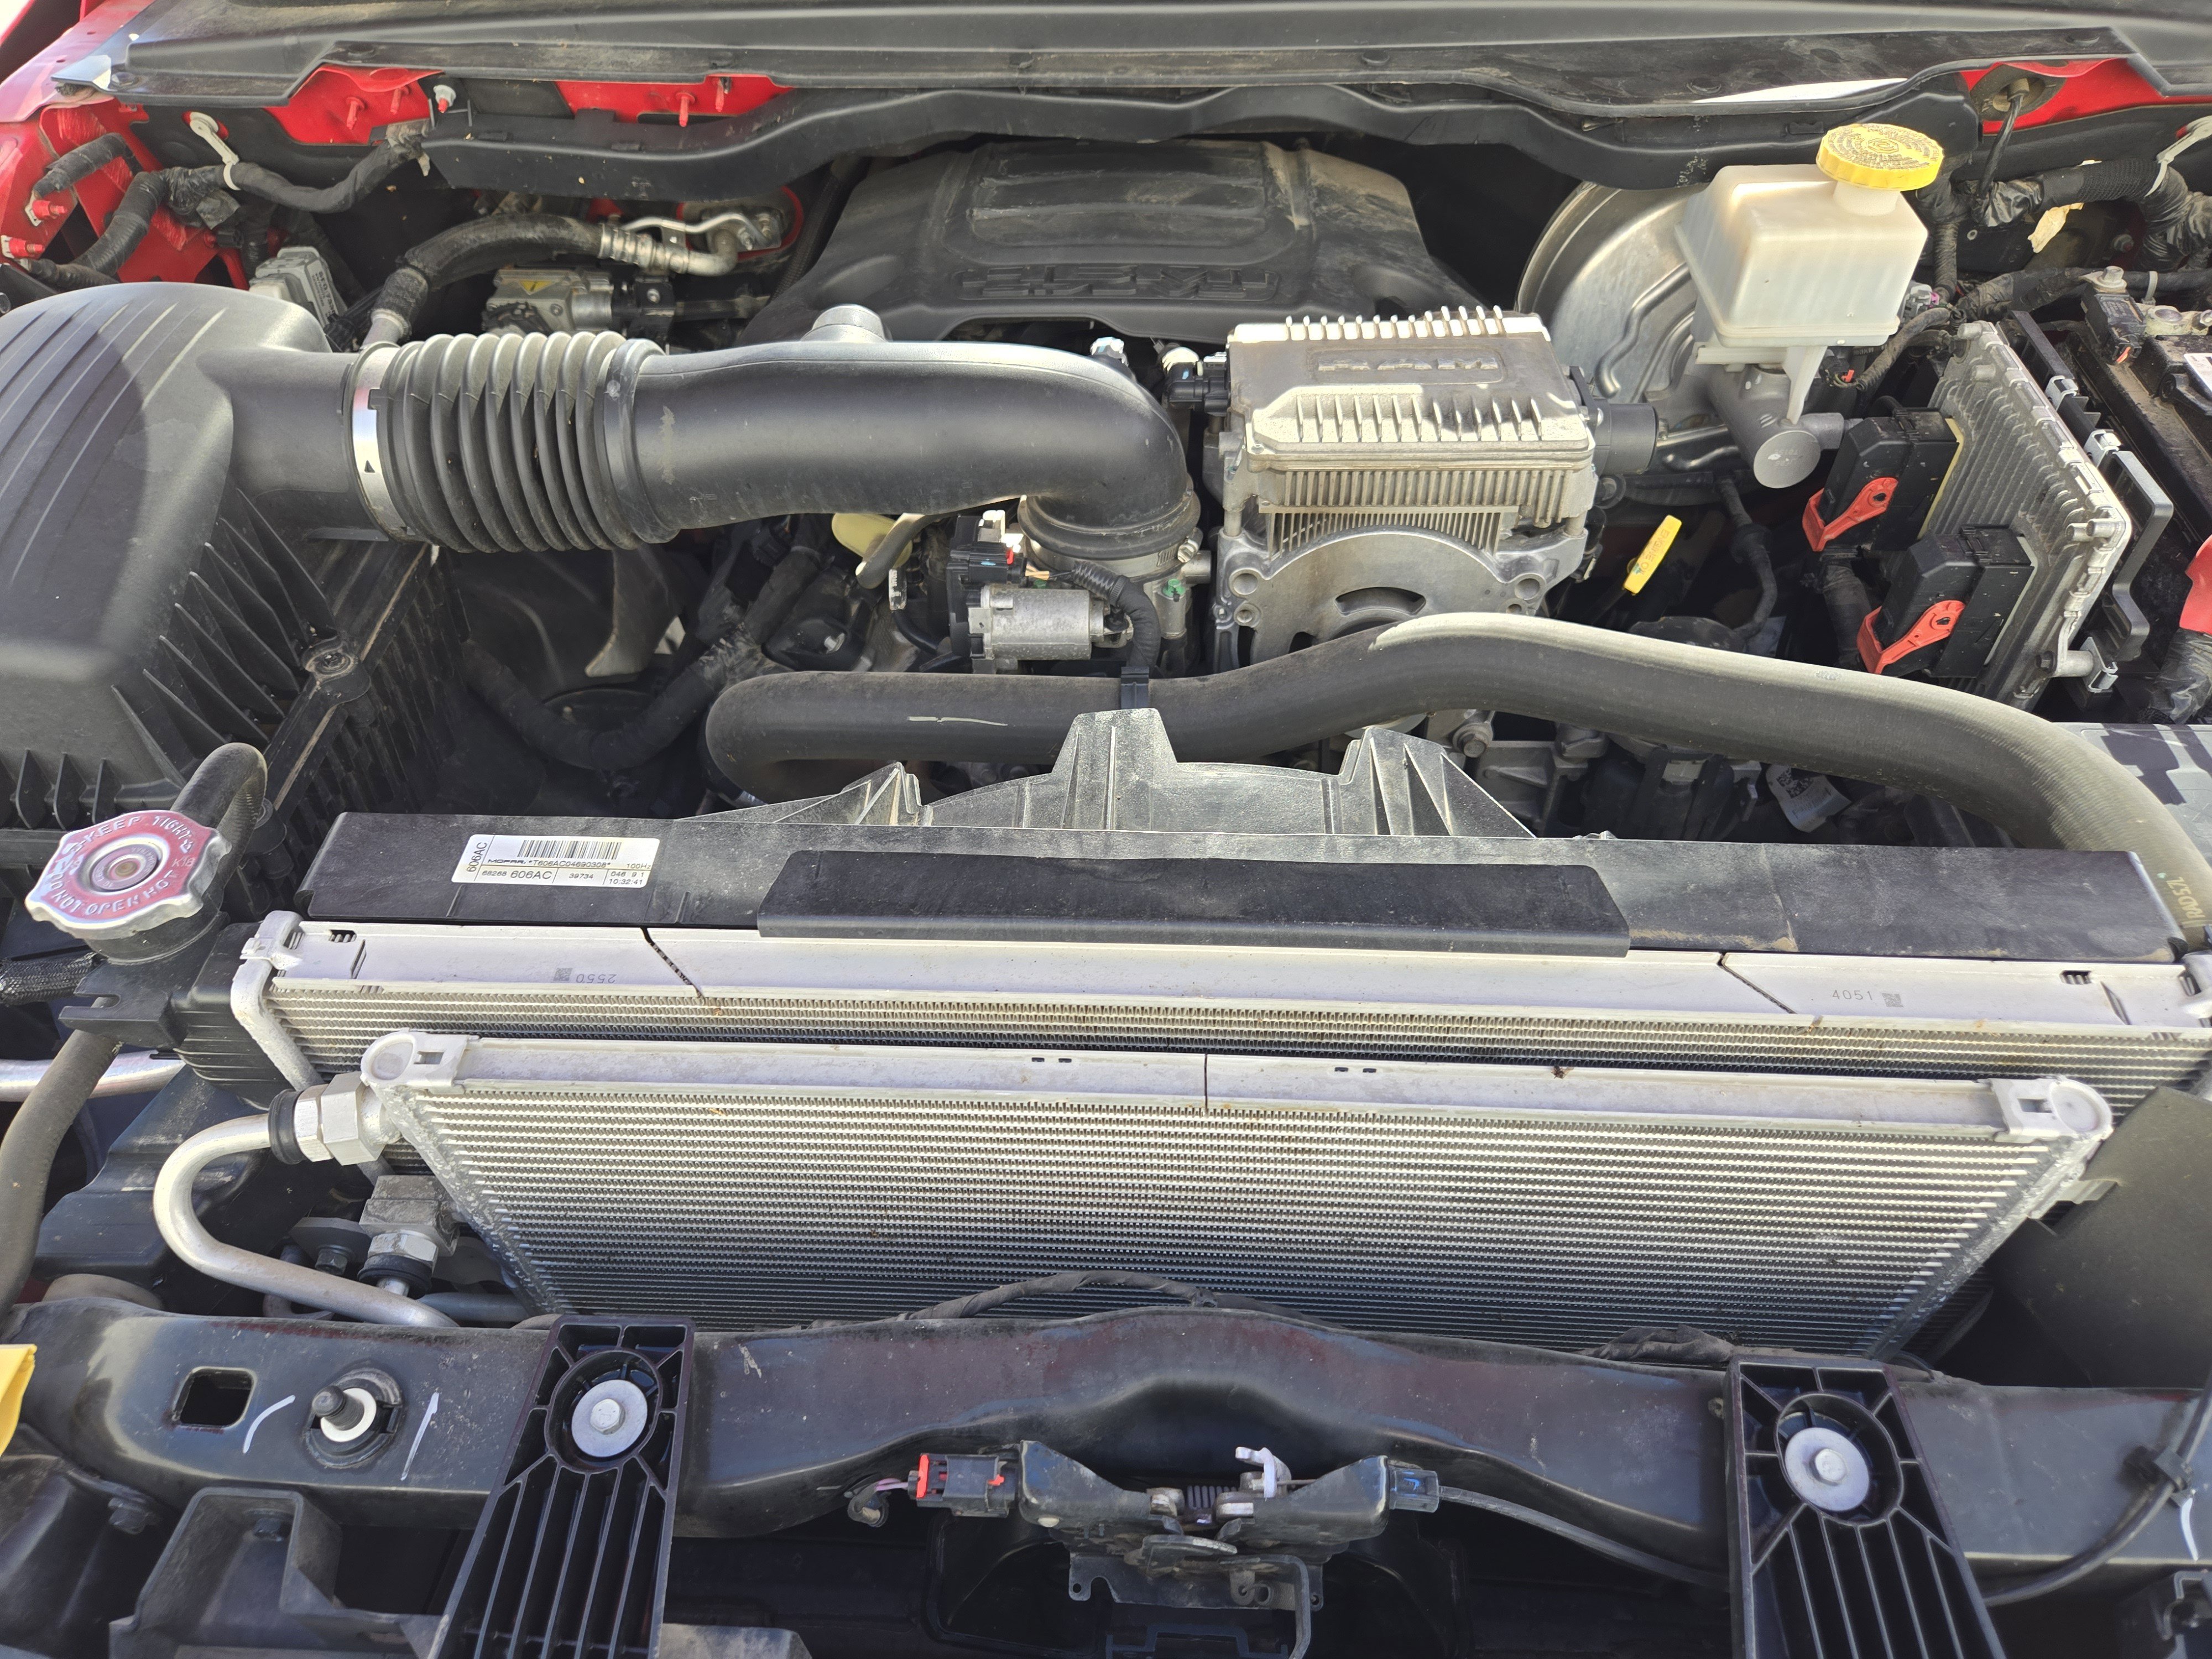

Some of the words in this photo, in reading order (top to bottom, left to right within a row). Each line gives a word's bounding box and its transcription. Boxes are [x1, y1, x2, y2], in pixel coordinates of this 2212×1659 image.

[1317, 357, 1499, 371] RAM
[1645, 529, 1670, 562] ENGINE
[83, 815, 142, 843] KEEP
[153, 815, 192, 841] TIGHT
[171, 857, 196, 869] K18
[466, 842, 487, 872] 606AC
[50, 871, 64, 890] DO
[143, 869, 180, 899] HOT
[510, 870, 552, 879] 606AC
[52, 890, 82, 912] NOT
[85, 896, 140, 915] OPEN
[2178, 895, 2206, 919] RAD
[575, 973, 617, 984] 2550
[1832, 989, 1873, 1000] 4051
